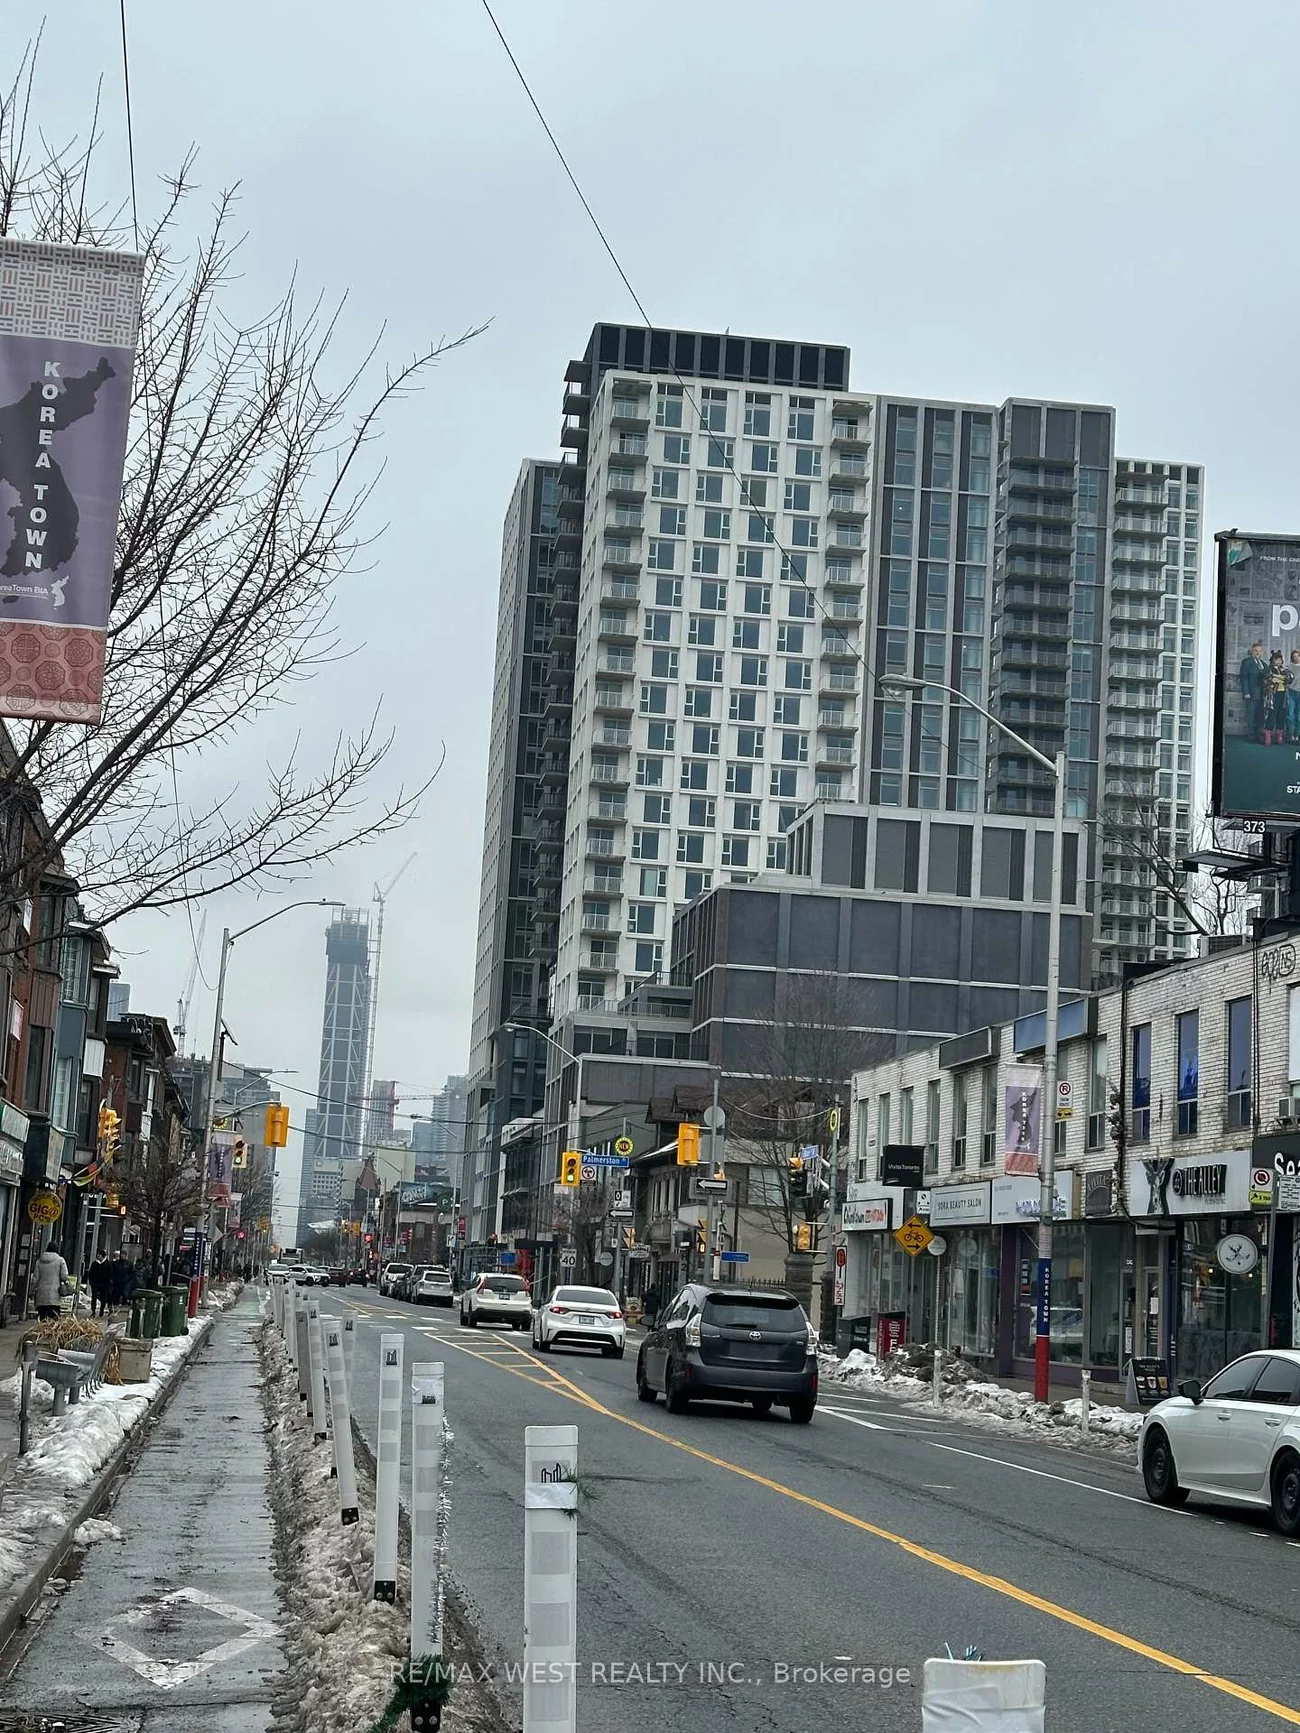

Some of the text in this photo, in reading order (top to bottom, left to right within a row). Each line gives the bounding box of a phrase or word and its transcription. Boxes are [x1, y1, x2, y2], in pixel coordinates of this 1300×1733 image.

[25, 361, 61, 569] KOREA TOWN
[1271, 603, 1300, 637] p
[1243, 820, 1266, 833] 373
[583, 1155, 620, 1165] Palmerston
[1183, 1164, 1222, 1195] THE ALLEY
[561, 1255, 576, 1266] 40
